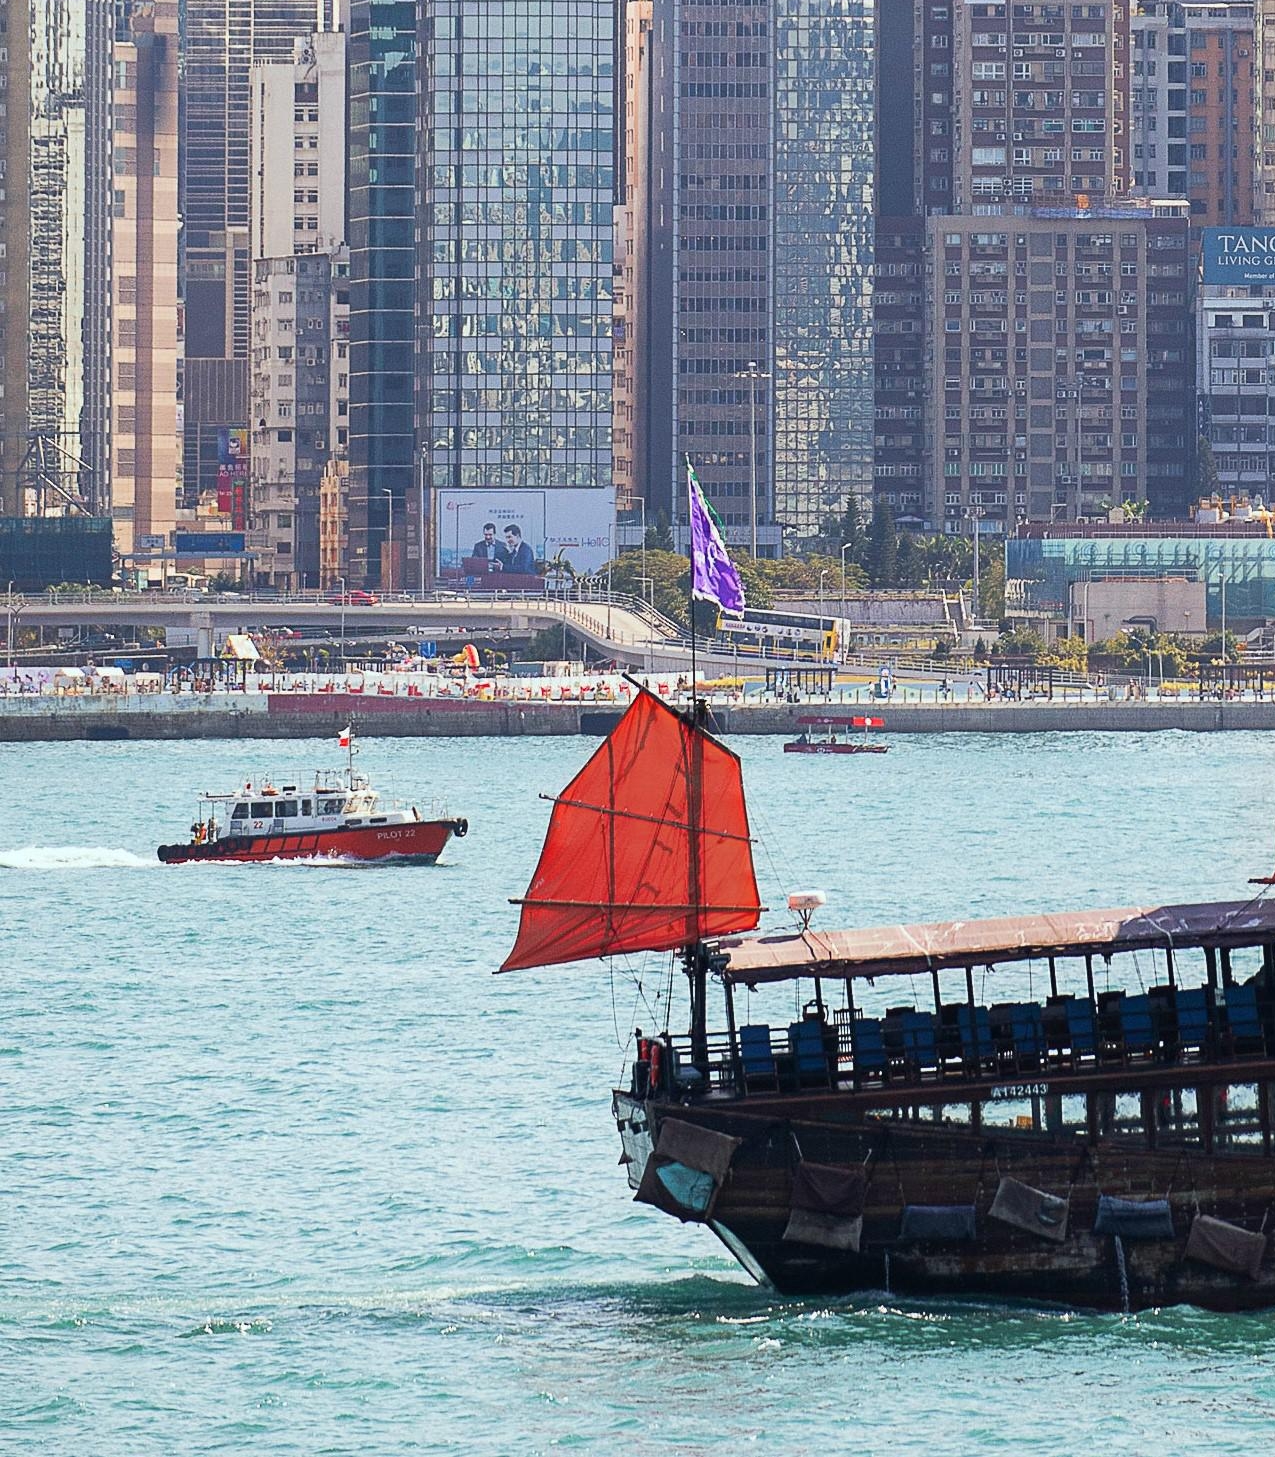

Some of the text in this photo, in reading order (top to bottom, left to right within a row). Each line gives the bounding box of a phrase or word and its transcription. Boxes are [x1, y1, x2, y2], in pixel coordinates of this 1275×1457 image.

[1218, 255, 1261, 265] LIVING
[1244, 272, 1267, 280] Member
[1268, 272, 1275, 280] of
[253, 820, 264, 830] 22
[377, 828, 416, 840] PILOT 22
